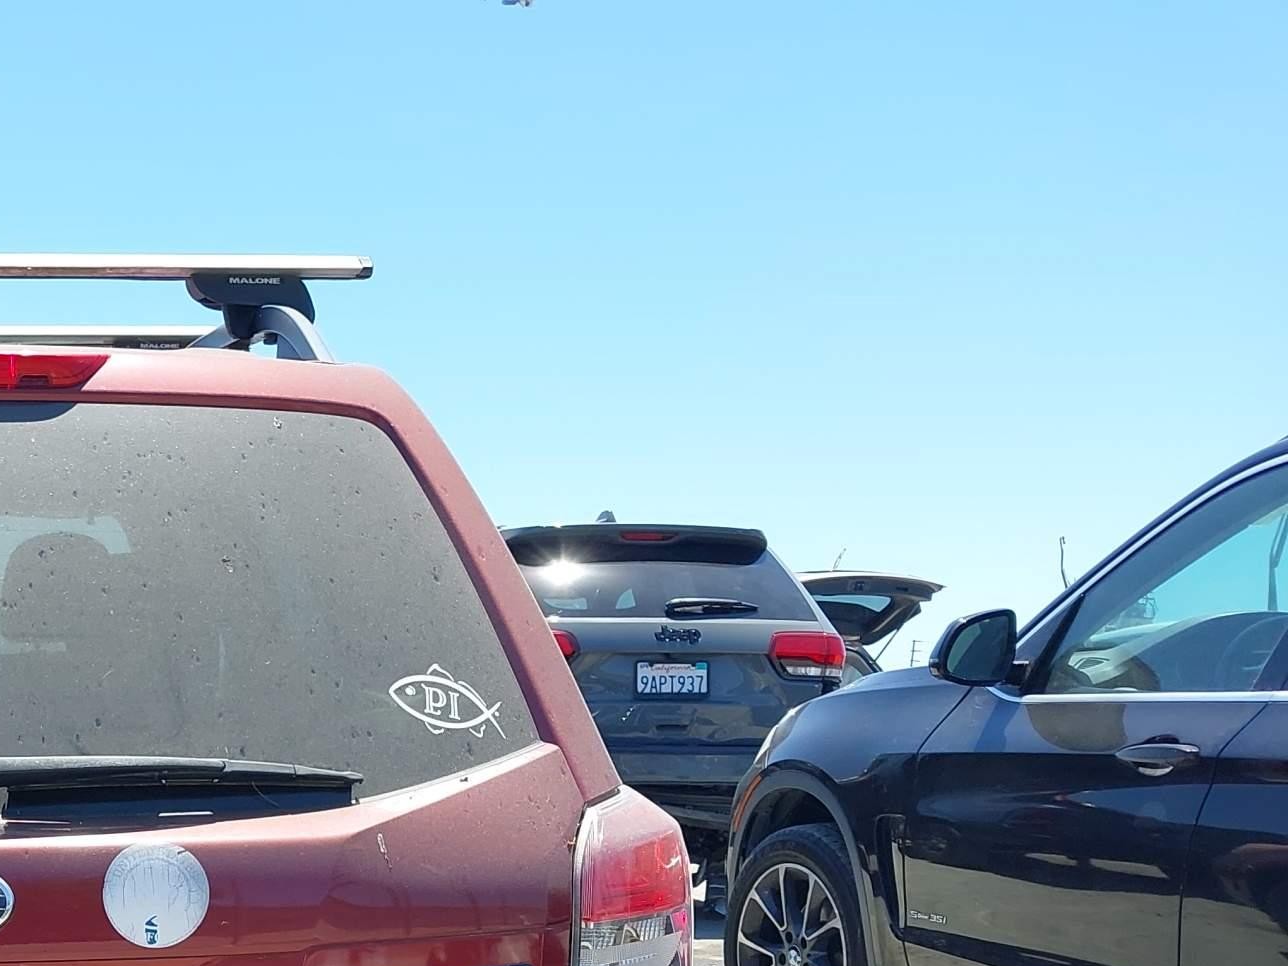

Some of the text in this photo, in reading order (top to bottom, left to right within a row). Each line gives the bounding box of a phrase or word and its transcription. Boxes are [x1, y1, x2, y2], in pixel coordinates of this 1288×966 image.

[229, 277, 281, 285] MALONE
[654, 625, 702, 645] Jeep
[640, 675, 704, 693] 9APT937
